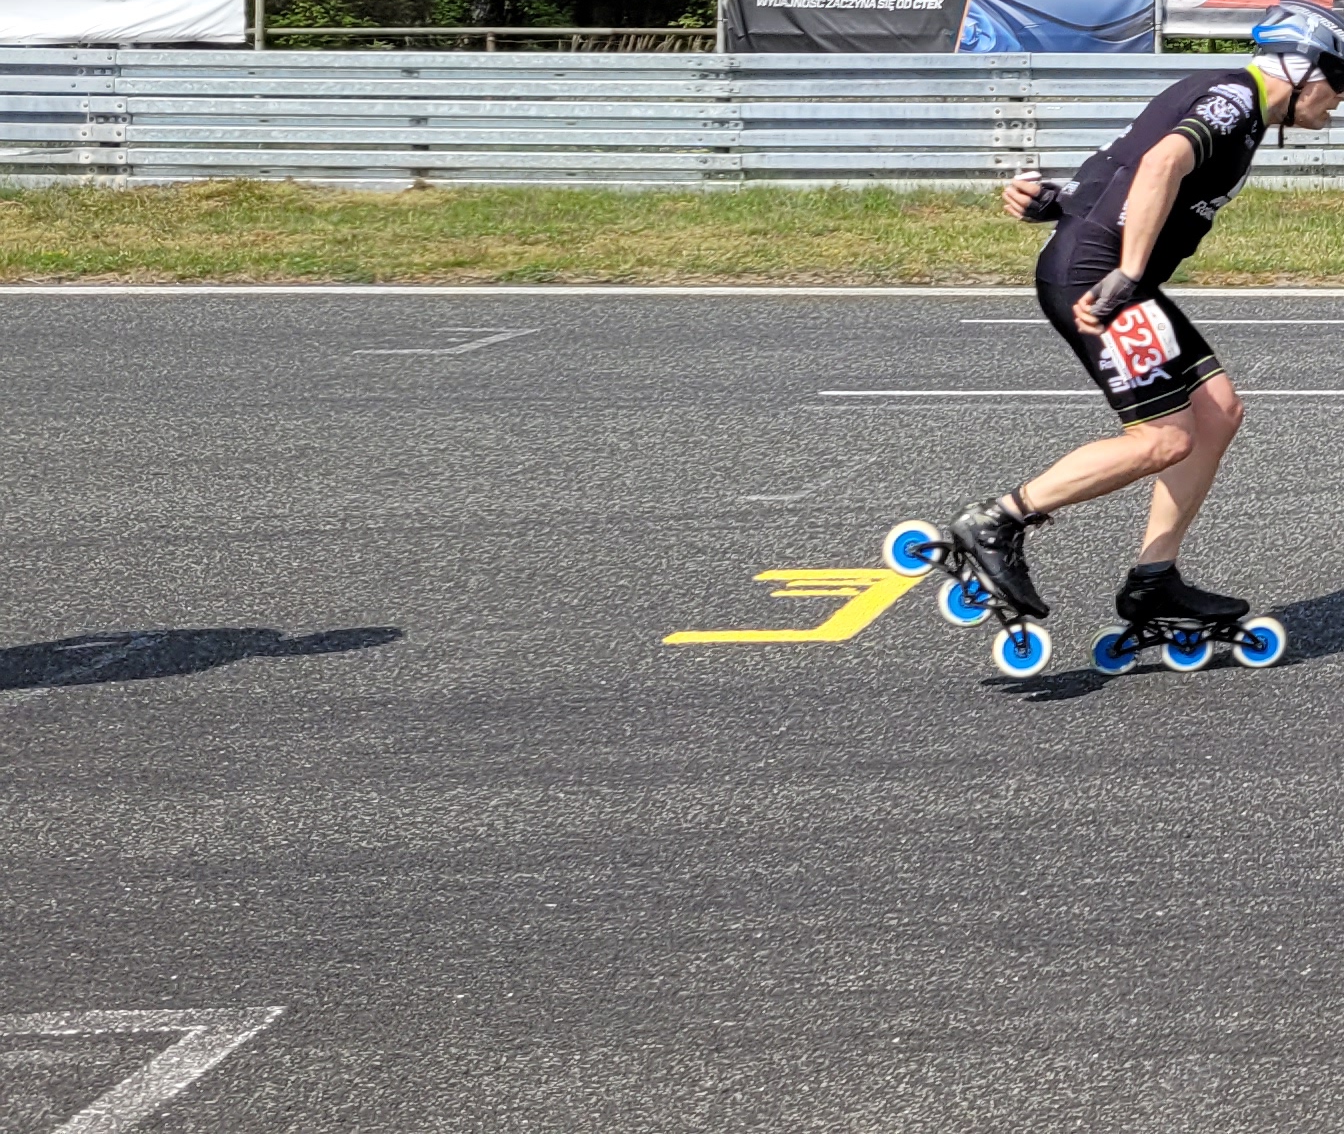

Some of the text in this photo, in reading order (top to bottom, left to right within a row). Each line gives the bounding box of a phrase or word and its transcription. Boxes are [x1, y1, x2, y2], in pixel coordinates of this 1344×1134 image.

[895, 0, 912, 9] OD
[912, 0, 945, 10] CTEK
[1112, 308, 1162, 374] 523
